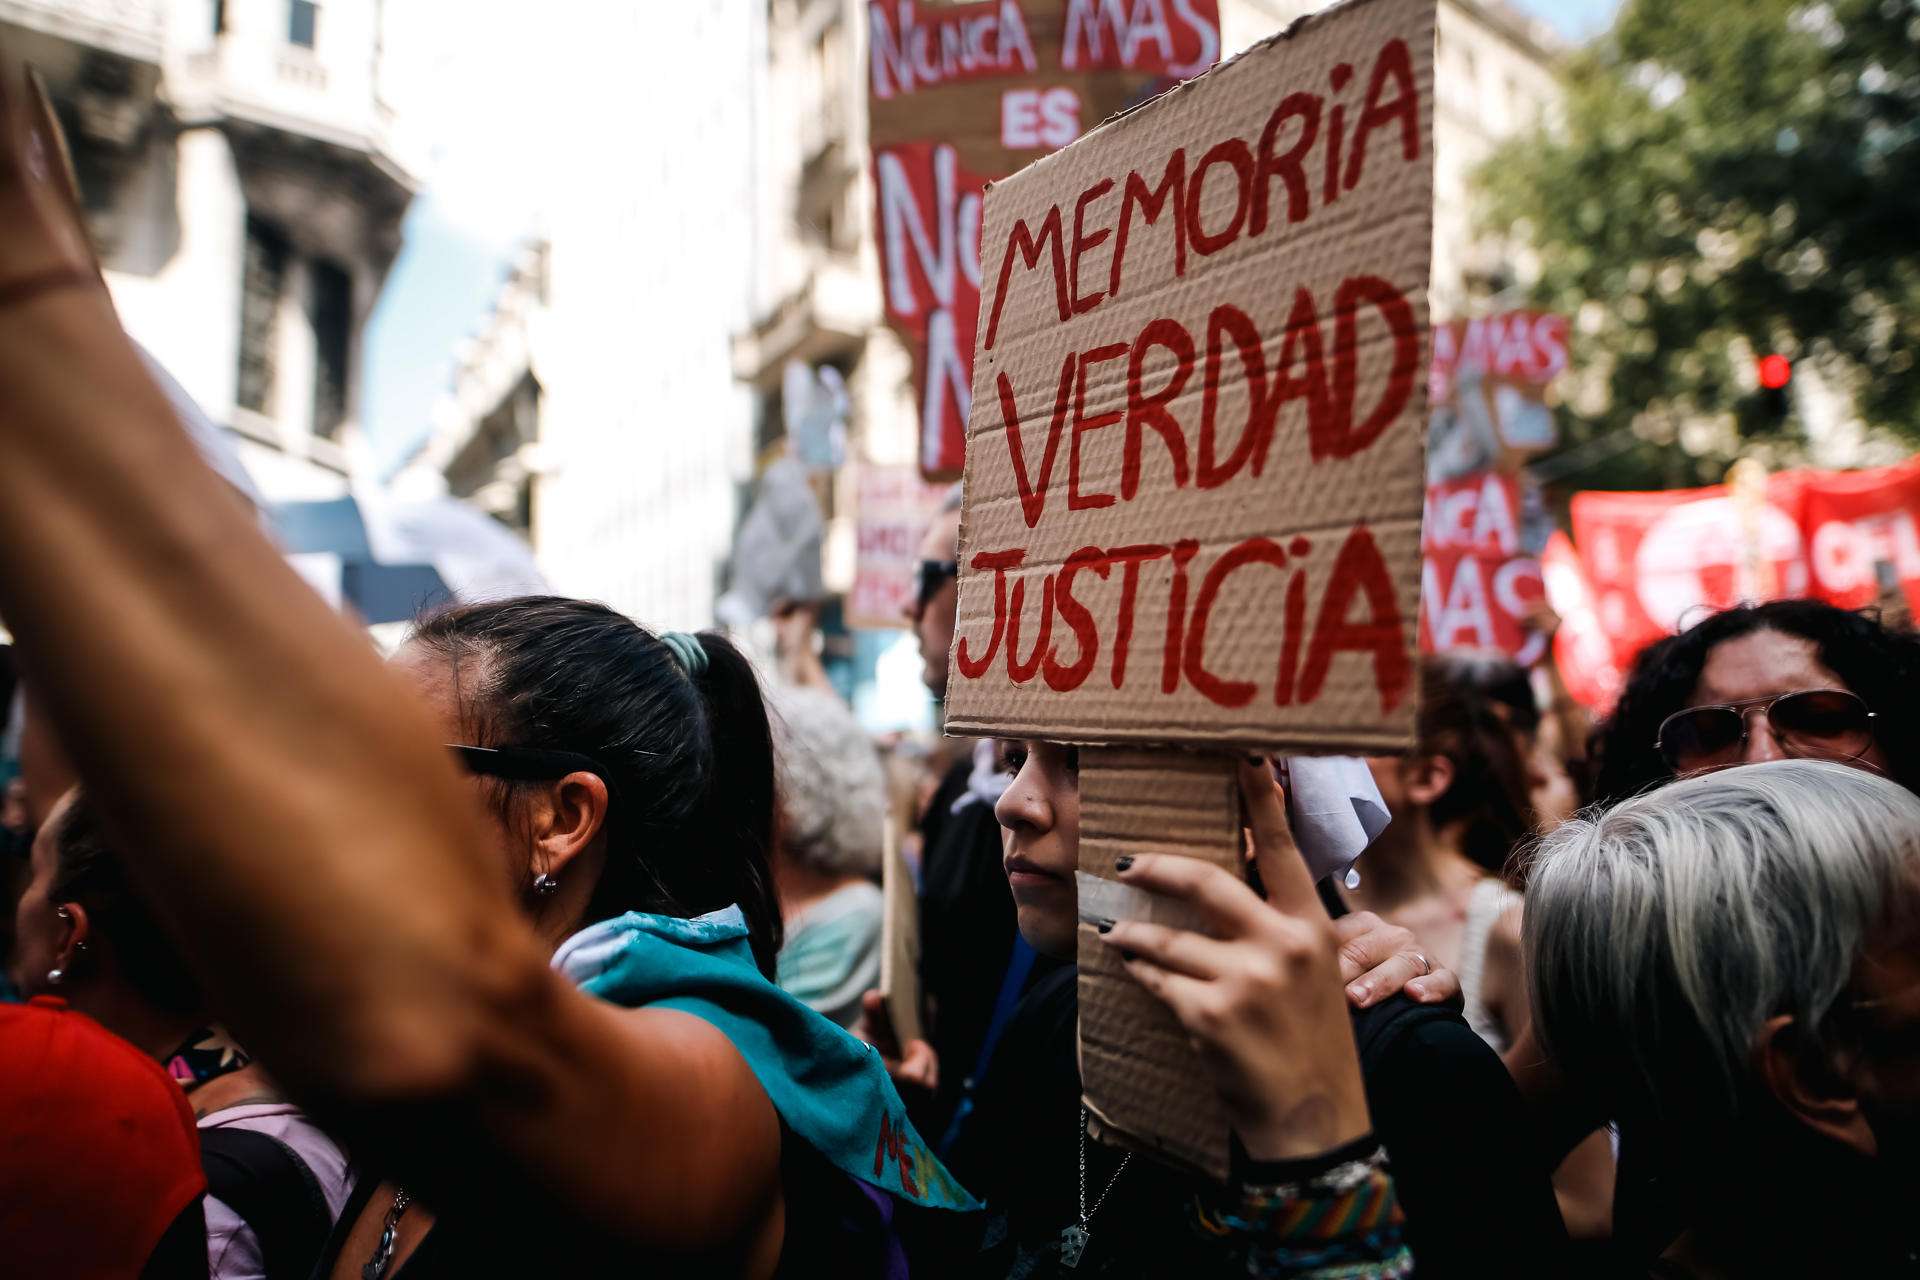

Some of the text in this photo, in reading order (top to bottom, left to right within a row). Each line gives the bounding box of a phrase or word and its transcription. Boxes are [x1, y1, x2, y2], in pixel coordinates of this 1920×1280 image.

[868, 1, 1037, 98] NUNCA
[1000, 88, 1080, 149] ES
[997, 276, 1418, 528] VERDAD
